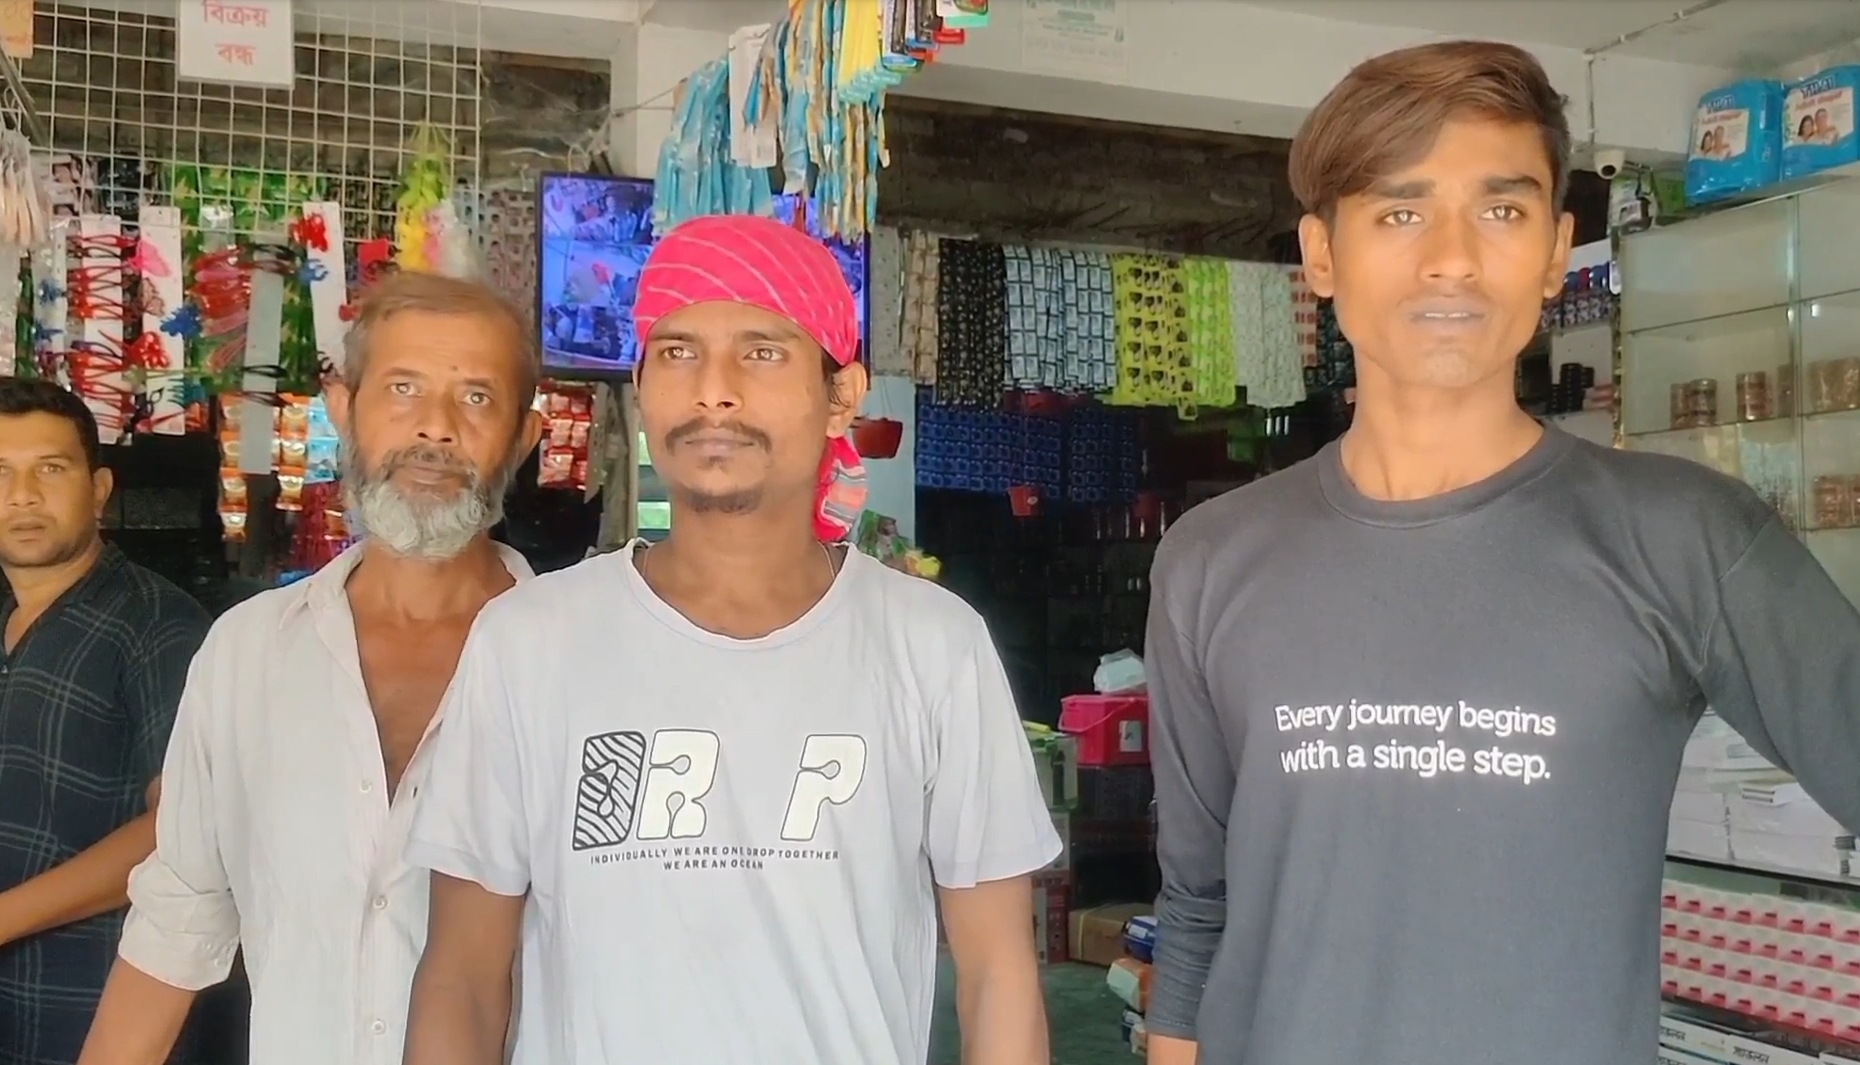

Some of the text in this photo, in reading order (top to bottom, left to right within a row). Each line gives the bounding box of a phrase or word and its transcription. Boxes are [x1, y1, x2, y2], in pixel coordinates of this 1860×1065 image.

[213, 43, 257, 66] বন্ধ
[1274, 698, 1557, 738] Every journey begins
[1280, 738, 1551, 786] with a single step.
[590, 848, 668, 865] INDIVIDUALLY
[674, 846, 692, 856] WE
[695, 846, 718, 856] ARE
[779, 849, 839, 860] TOGETHER
[663, 860, 681, 871] WE
[684, 859, 708, 869] ARE
[711, 860, 727, 869] AN
